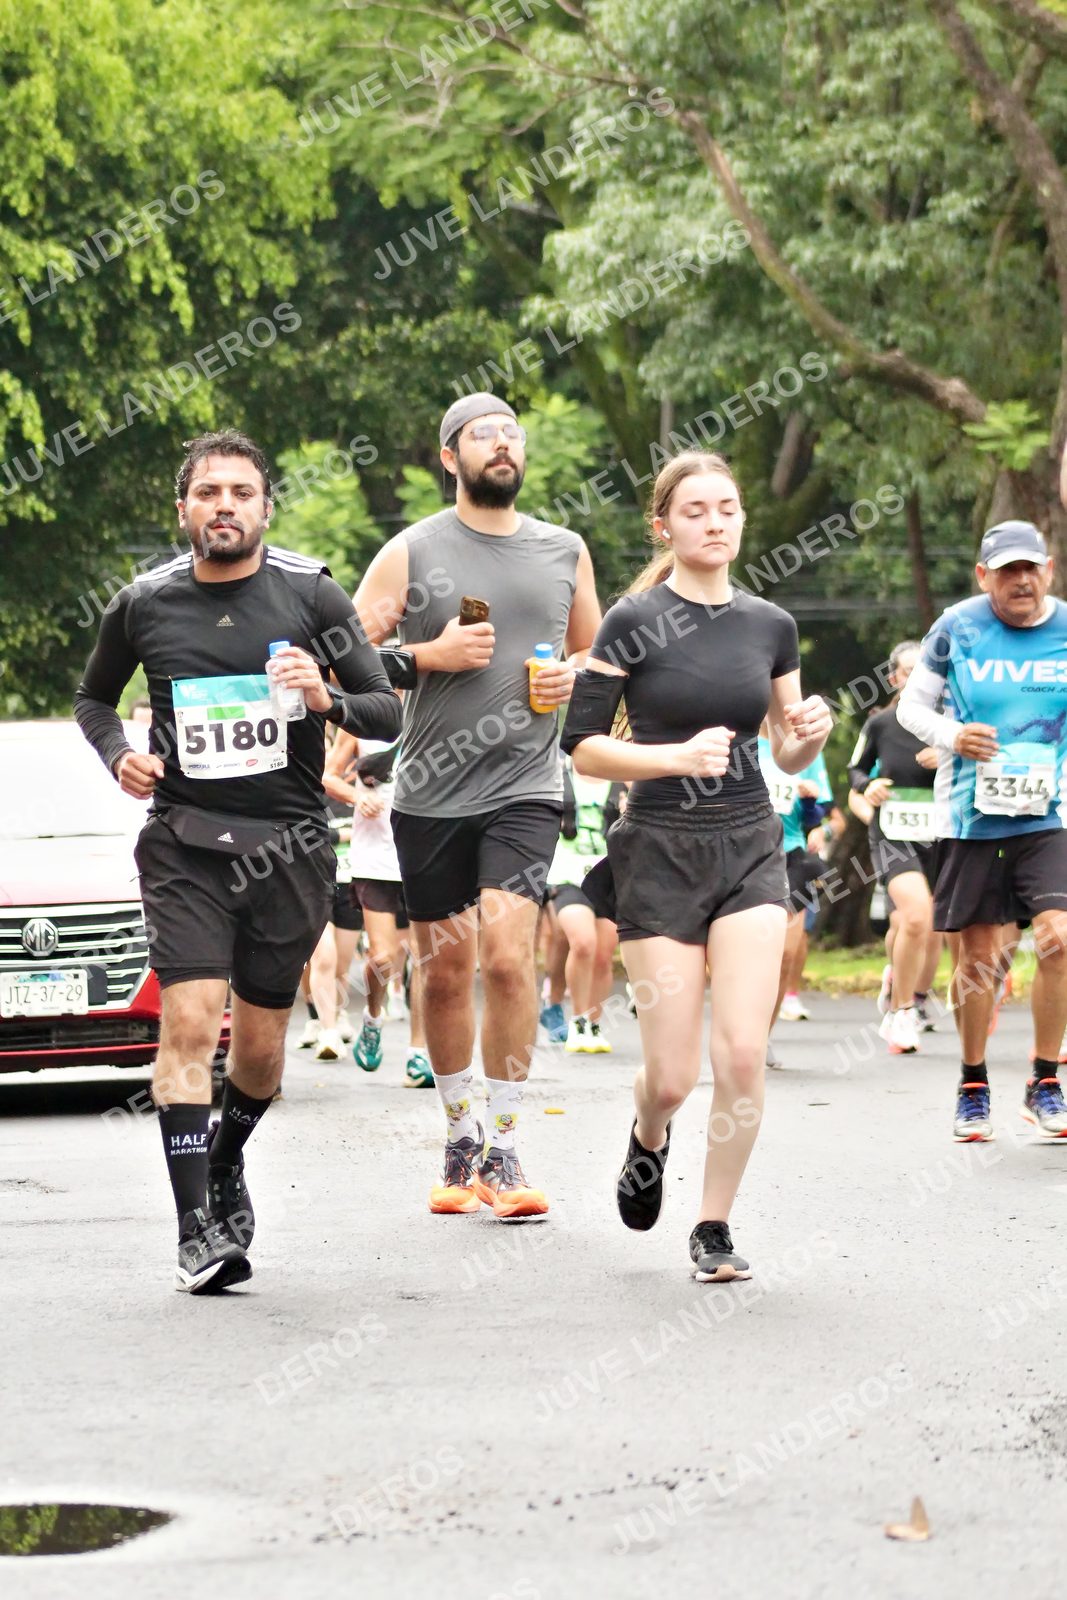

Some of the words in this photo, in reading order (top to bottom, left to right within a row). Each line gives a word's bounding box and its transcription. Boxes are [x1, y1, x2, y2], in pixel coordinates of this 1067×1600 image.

[184, 718, 279, 755] 5180
[983, 777, 1050, 800] 3344
[887, 811, 929, 827] 1531
[26, 921, 57, 952] MG
[170, 1133, 207, 1148] HALF
